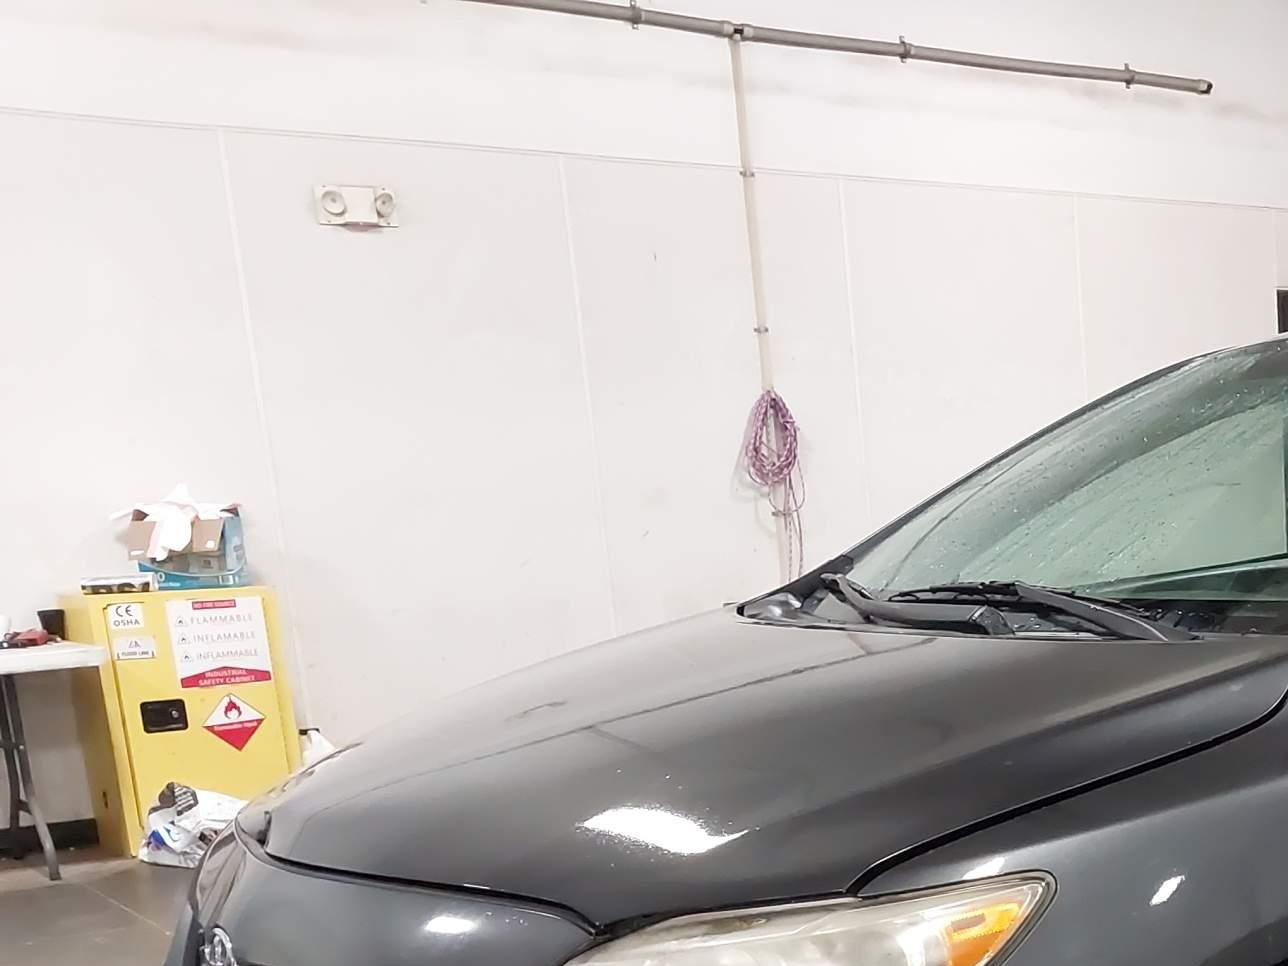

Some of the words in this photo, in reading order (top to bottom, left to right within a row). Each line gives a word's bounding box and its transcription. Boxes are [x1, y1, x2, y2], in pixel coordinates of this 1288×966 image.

[115, 605, 133, 617] CE
[113, 618, 140, 627] OSHA
[190, 613, 253, 625] FLAMMABLE
[193, 631, 256, 642] INFLAMABLE
[196, 648, 258, 660] INFLAMMABLE
[204, 669, 247, 678] INDUSTRIAL
[198, 677, 223, 686] SAFETY
[225, 675, 255, 684] CABINET
